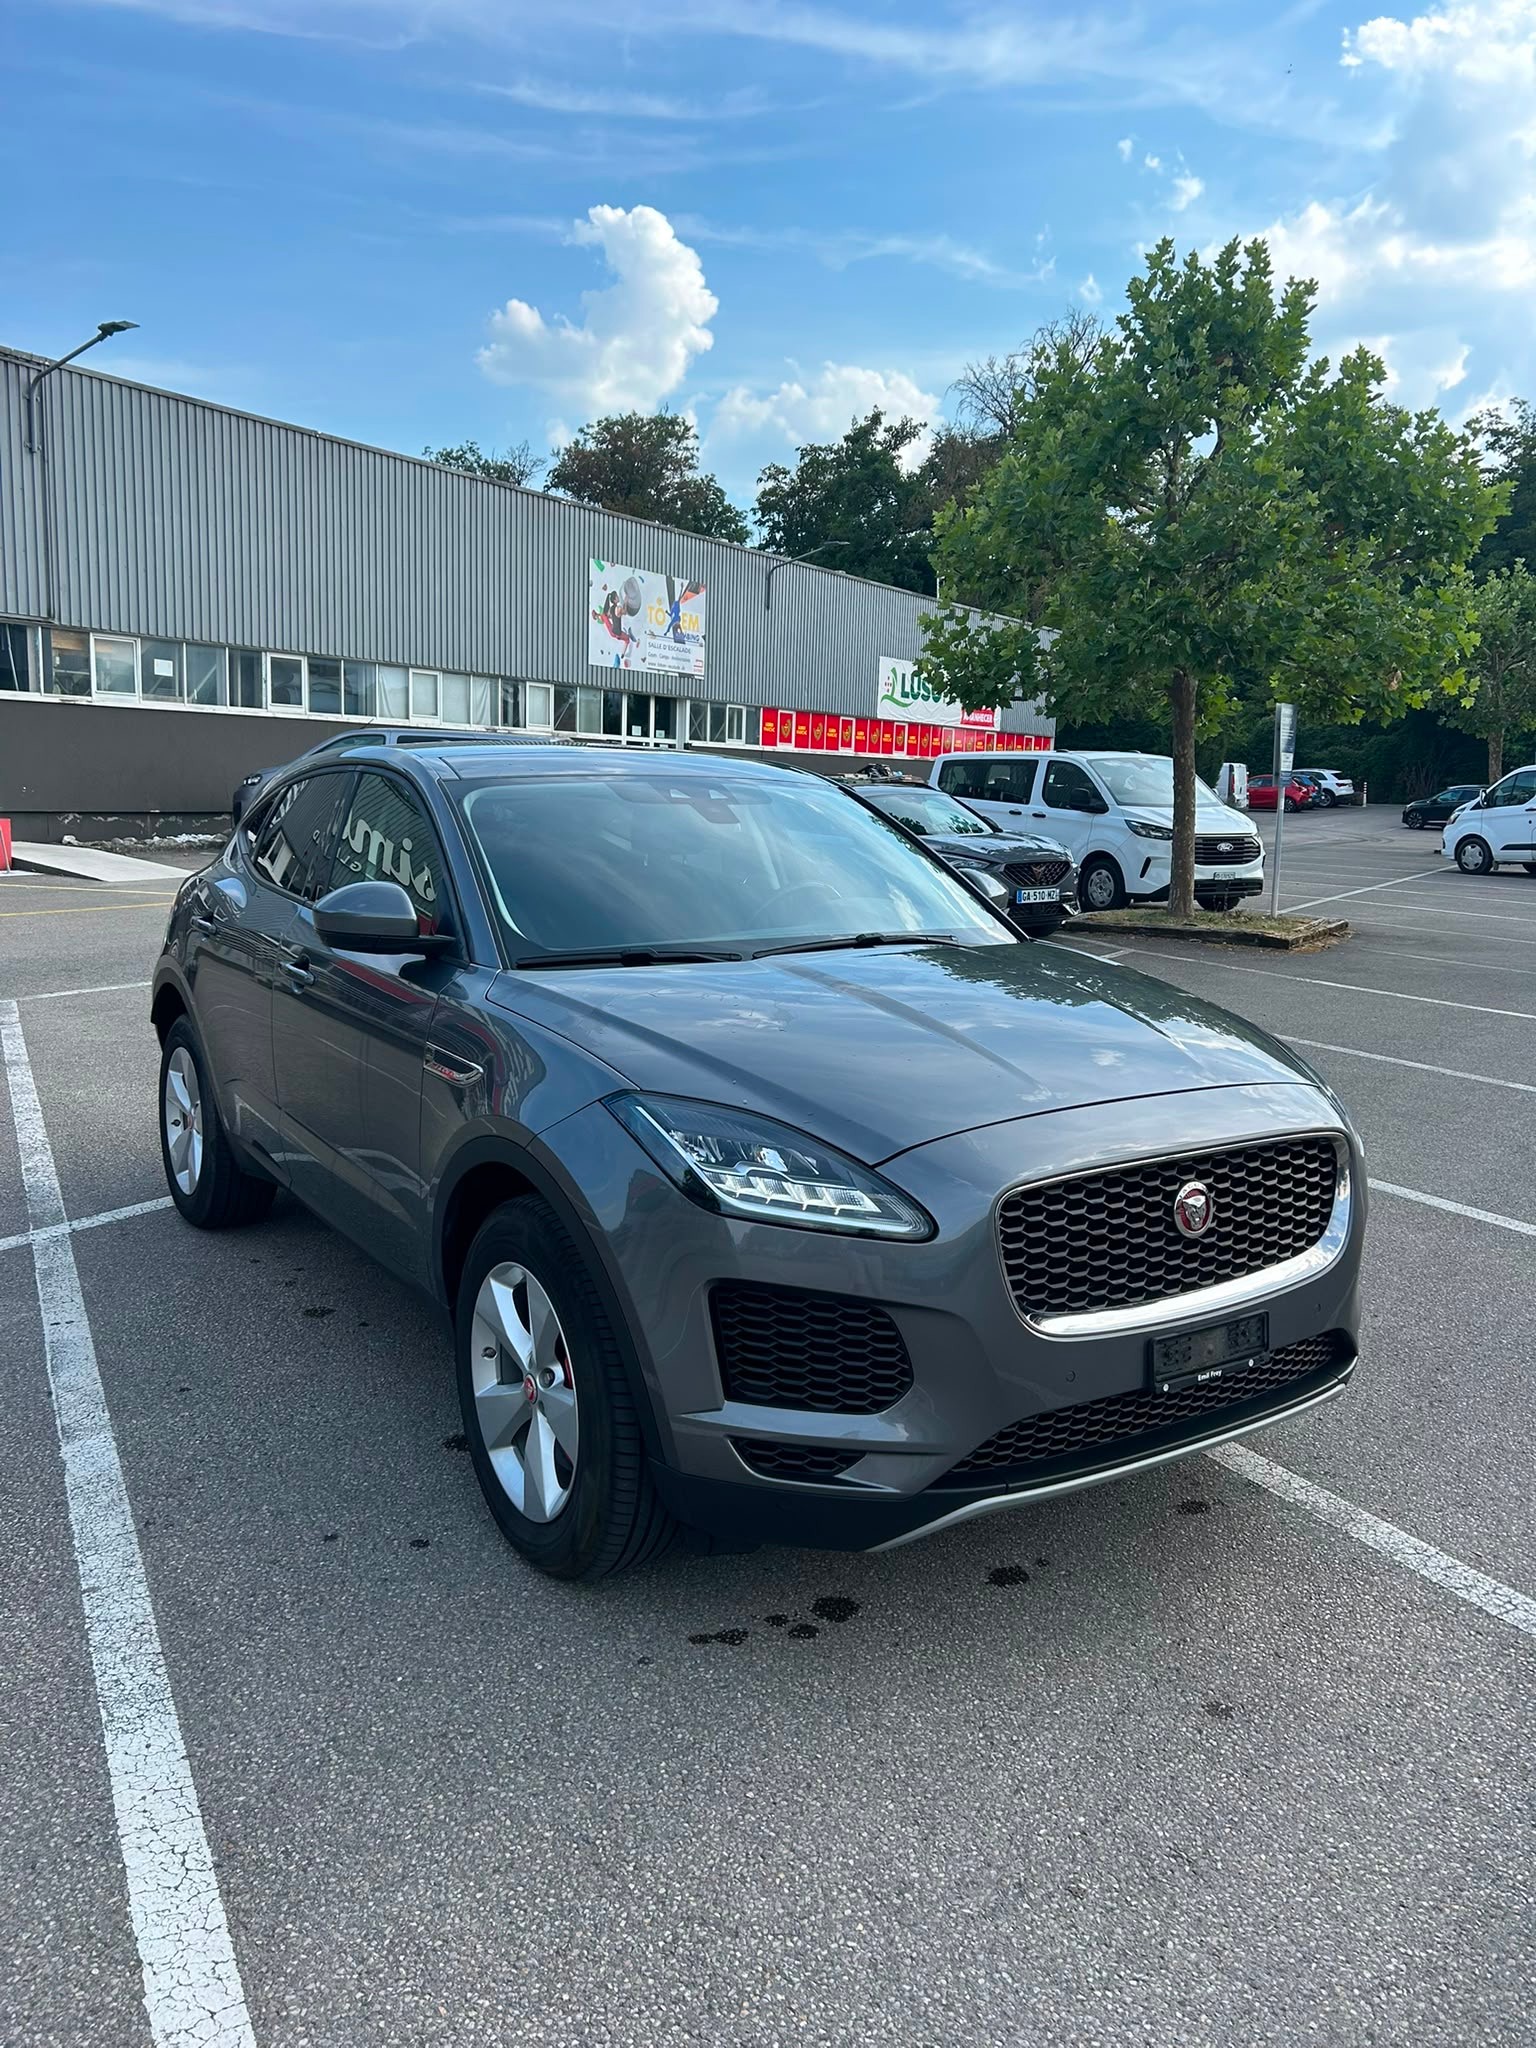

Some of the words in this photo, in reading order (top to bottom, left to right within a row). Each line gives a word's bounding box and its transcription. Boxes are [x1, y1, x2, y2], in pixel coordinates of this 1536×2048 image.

[648, 641, 663, 650] SALLE
[1197, 1371, 1210, 1382] Emil
[1210, 1369, 1223, 1379] Frey
